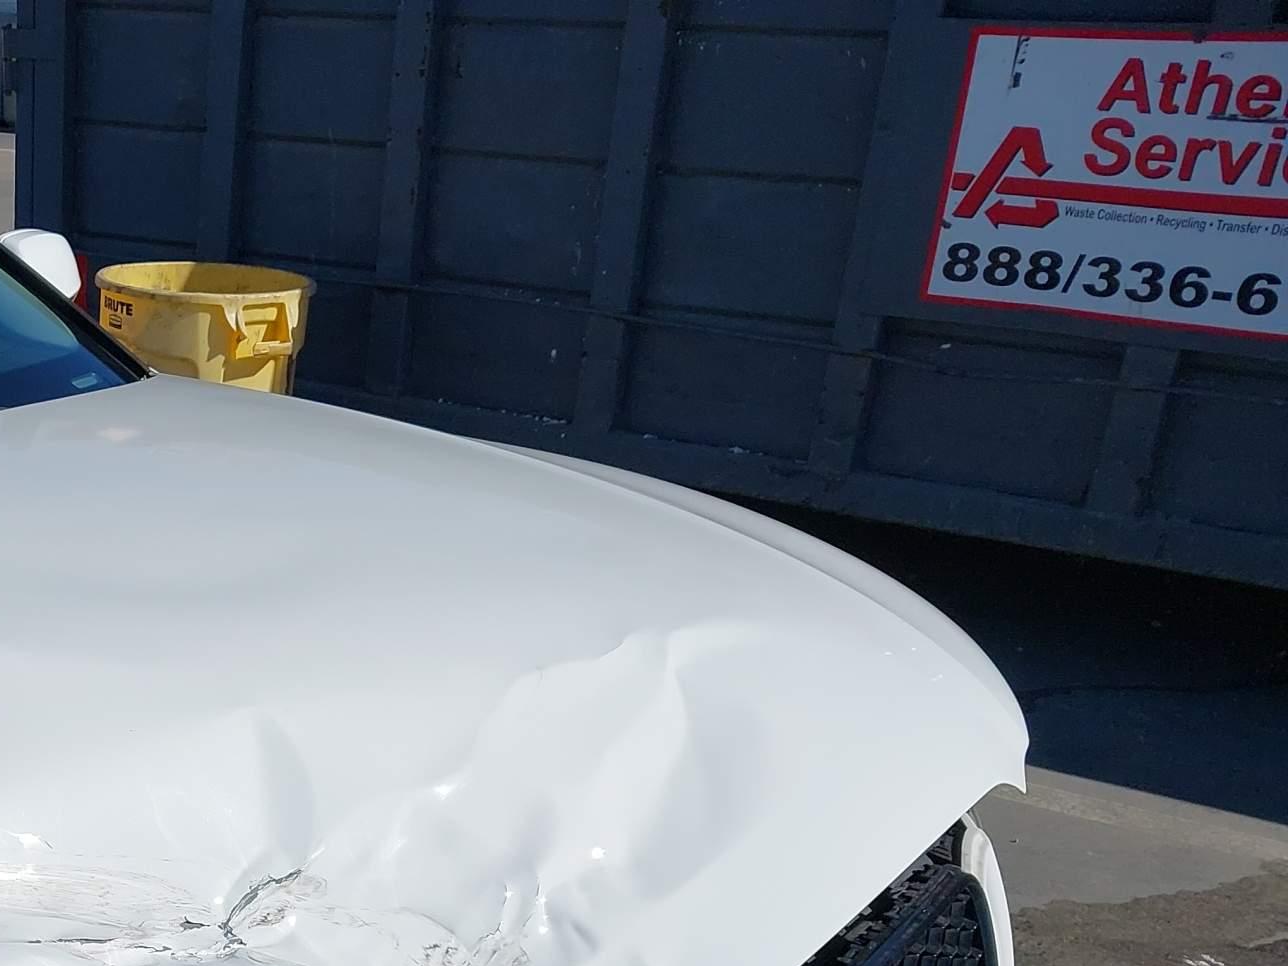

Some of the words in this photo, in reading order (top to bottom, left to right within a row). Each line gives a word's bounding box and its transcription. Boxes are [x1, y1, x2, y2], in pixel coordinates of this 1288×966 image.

[1097, 57, 1288, 118] Athe
[1064, 205, 1096, 219] Waste
[1097, 208, 1148, 225] Collection
[1156, 213, 1207, 233] Recycling
[1216, 218, 1263, 235] Transfer
[942, 242, 1282, 316] 888/336-6
[103, 295, 134, 317] BRUTE
